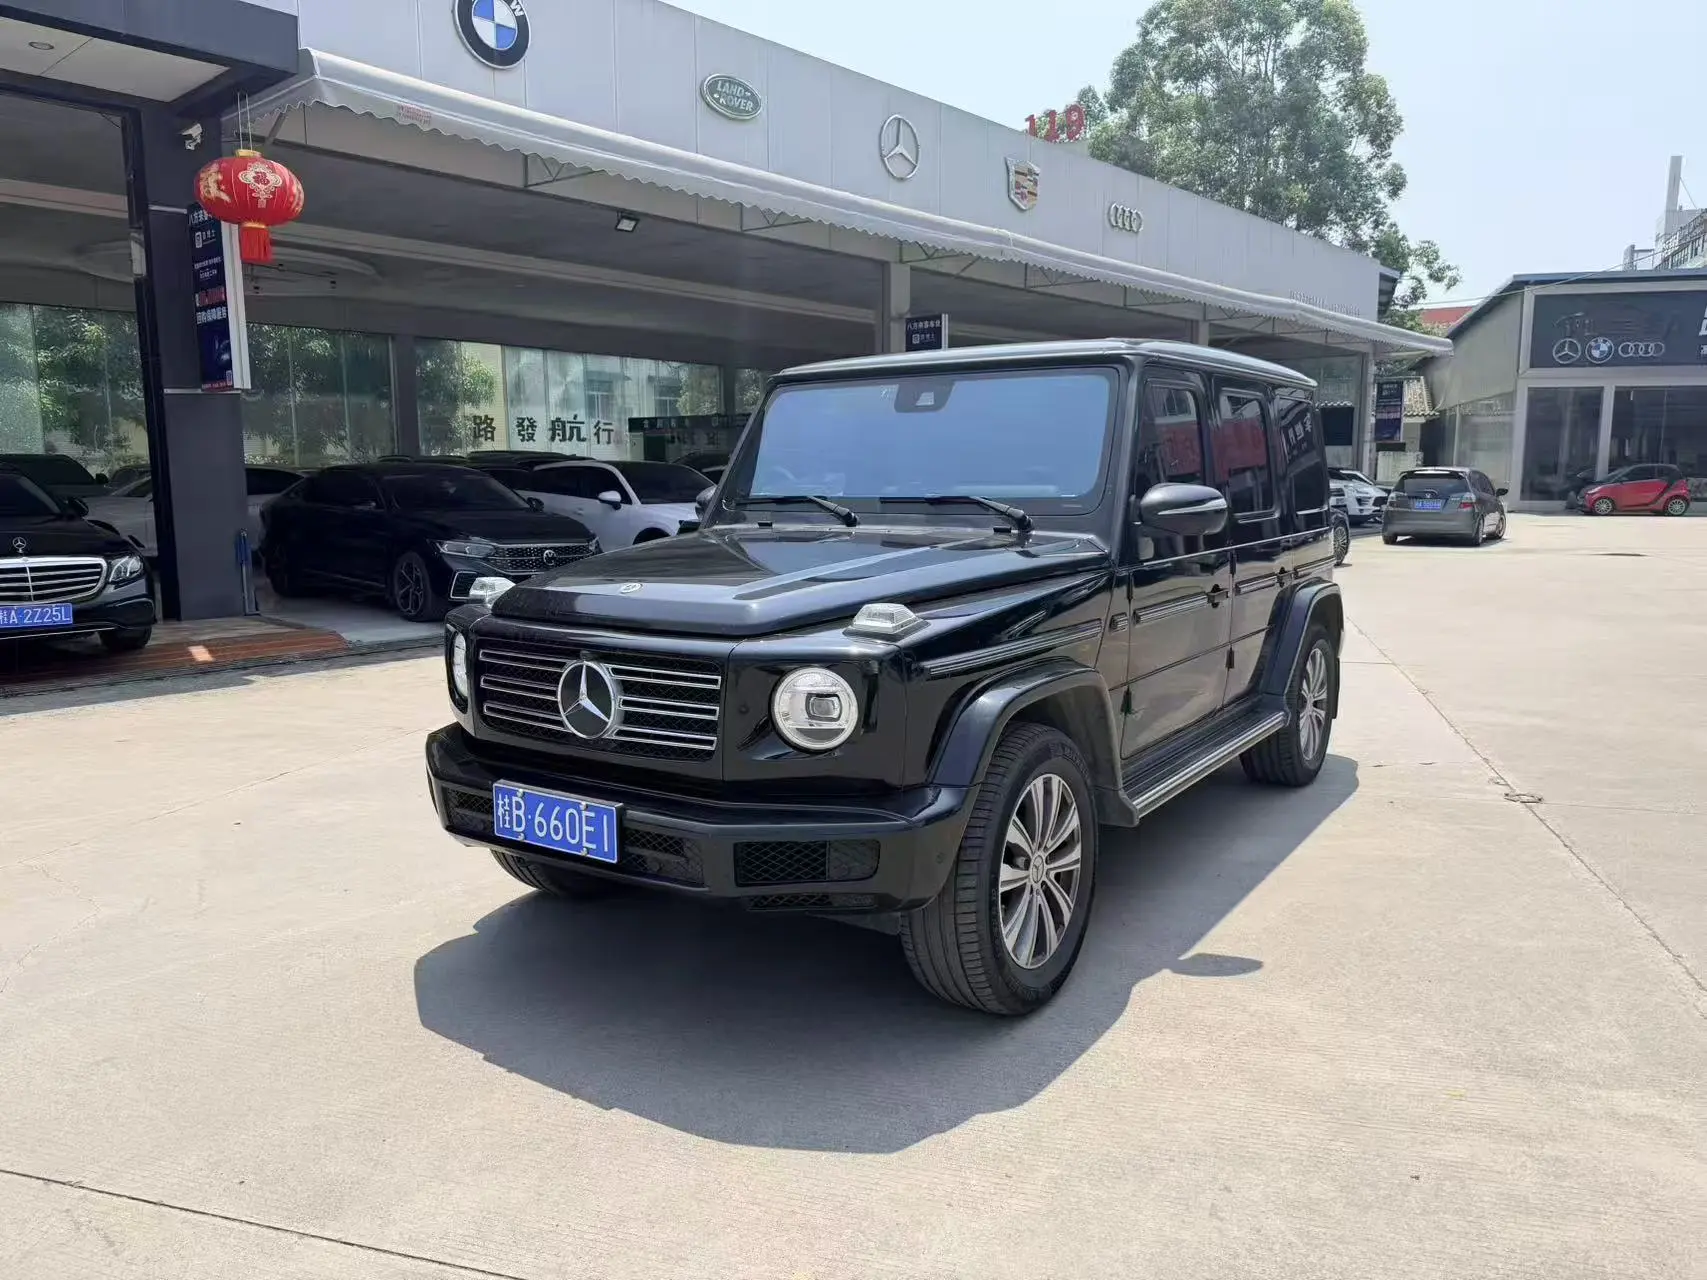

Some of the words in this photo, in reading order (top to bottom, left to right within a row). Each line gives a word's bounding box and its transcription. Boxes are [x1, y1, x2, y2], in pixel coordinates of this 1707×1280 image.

[717, 80, 745, 98] LAND
[720, 93, 754, 111] ROVER
[1025, 104, 1085, 142] 119
